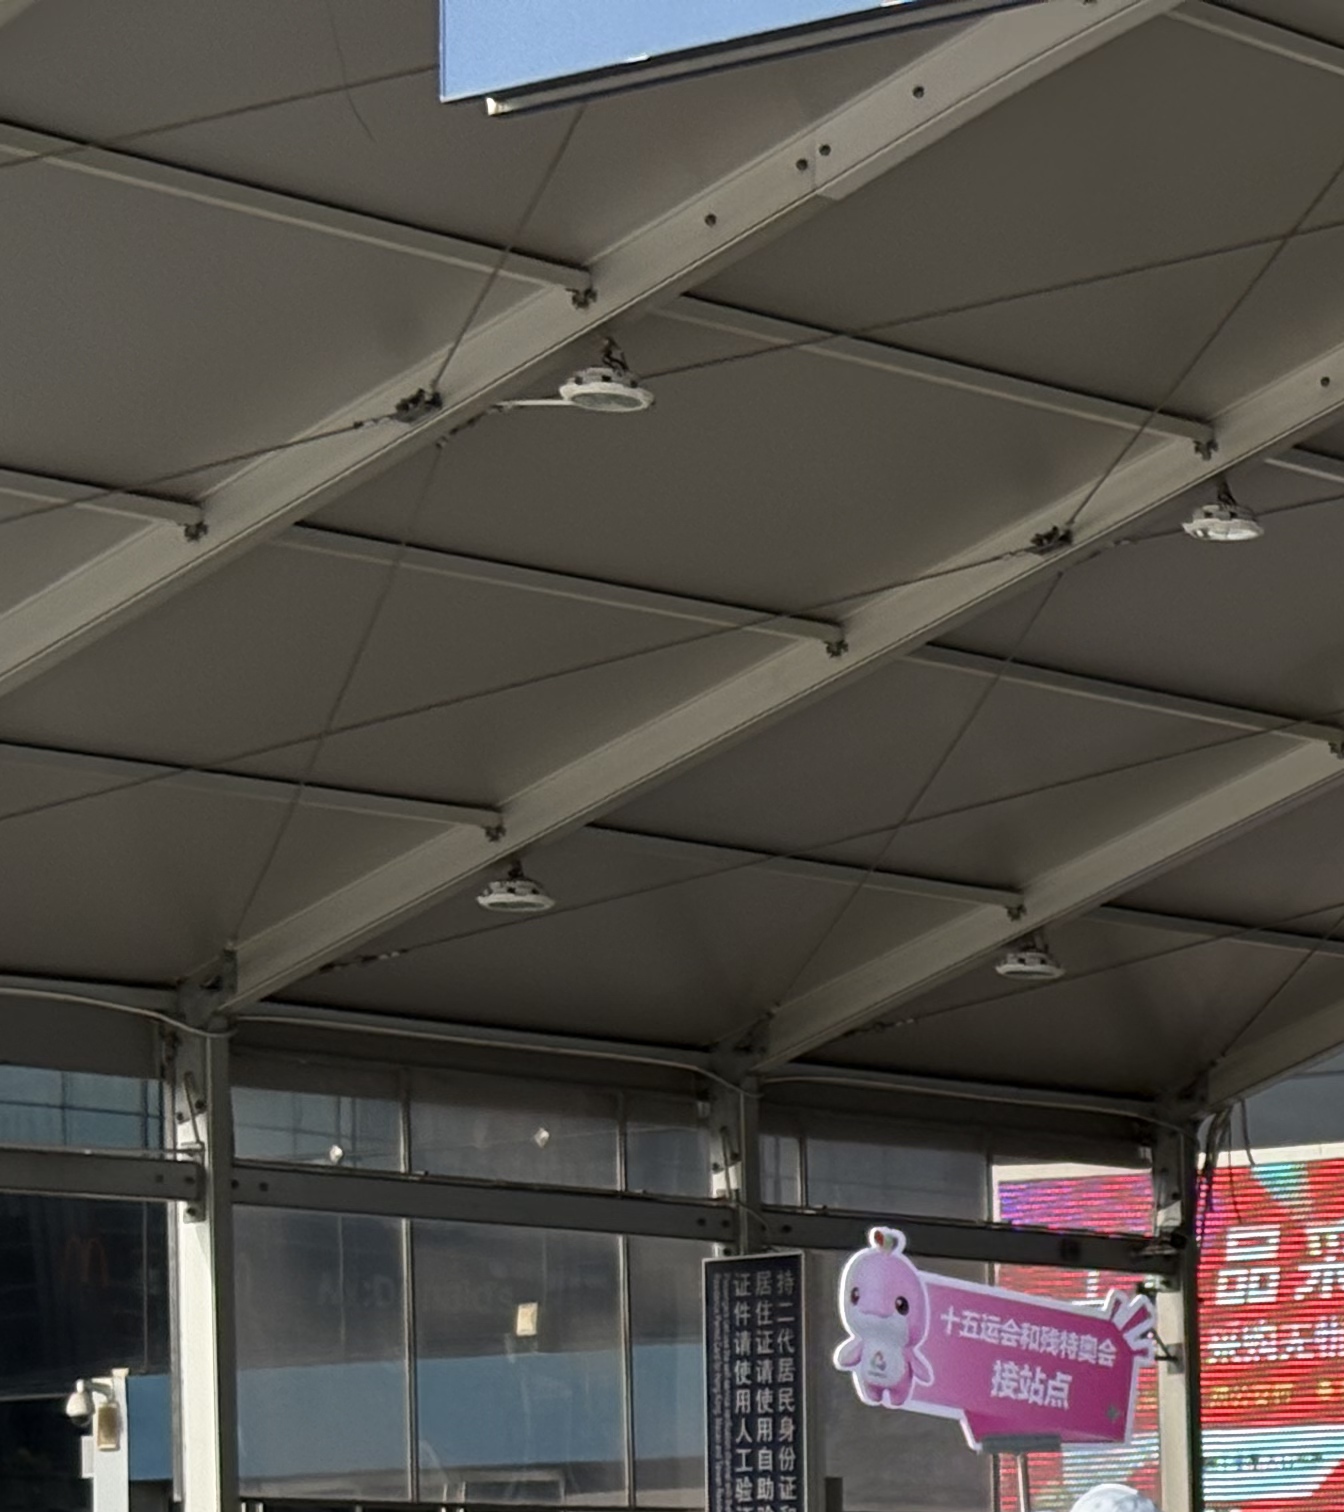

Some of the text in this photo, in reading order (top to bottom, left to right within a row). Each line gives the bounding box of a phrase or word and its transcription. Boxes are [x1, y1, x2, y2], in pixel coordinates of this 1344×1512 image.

[940, 1305, 1117, 1368] 十五运会和残特奥会
[990, 1359, 1073, 1410] 接站点
